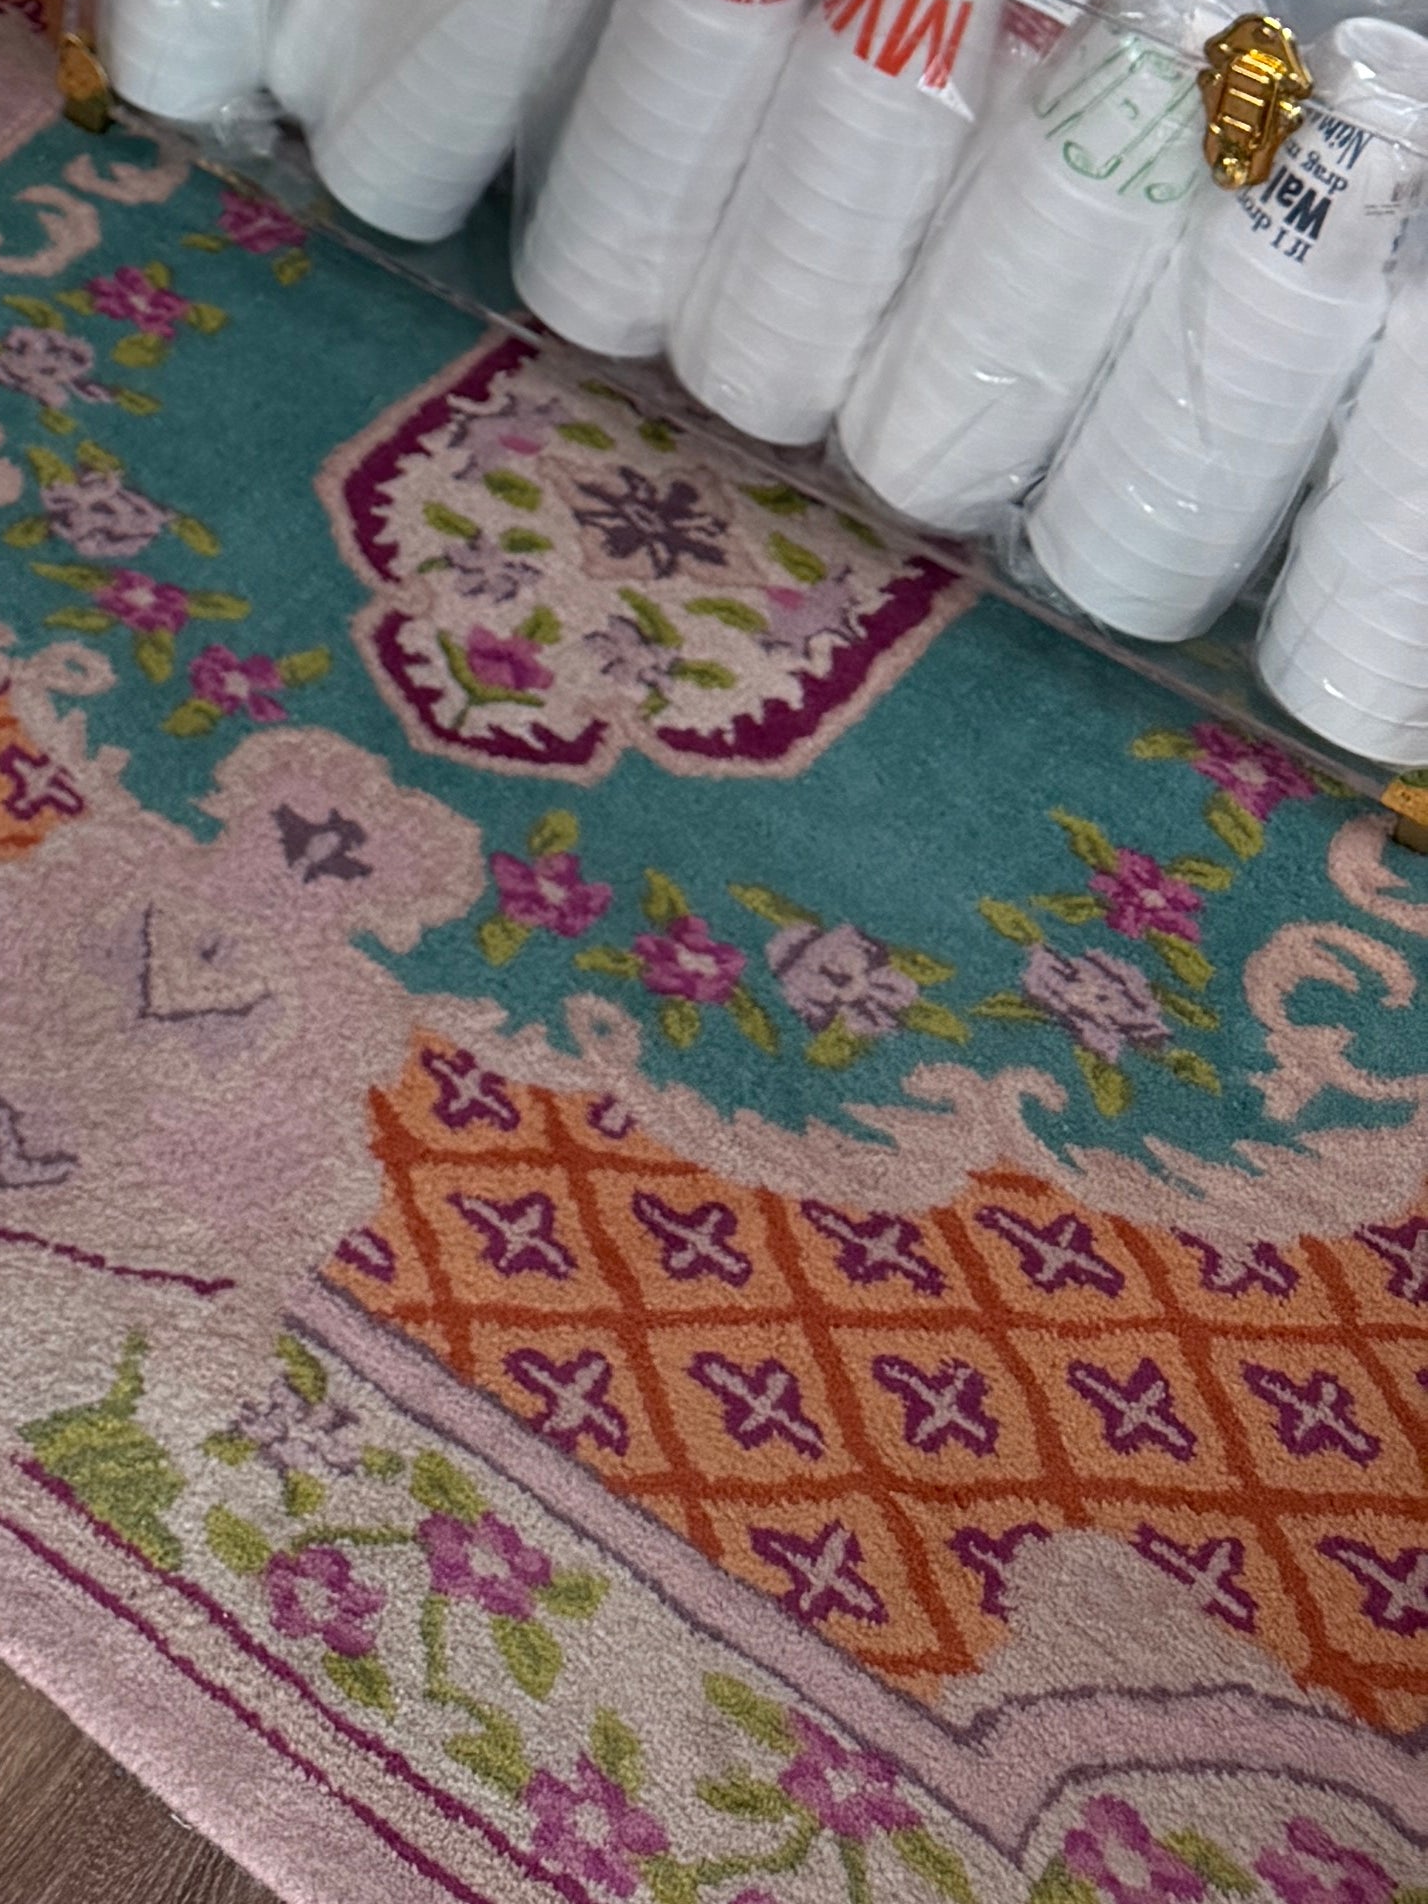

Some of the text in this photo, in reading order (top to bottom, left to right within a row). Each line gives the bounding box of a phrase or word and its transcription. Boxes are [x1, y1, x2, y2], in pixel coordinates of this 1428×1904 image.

[1300, 150, 1348, 194] drag
[1269, 227, 1287, 250] I
[1282, 238, 1313, 264] If
